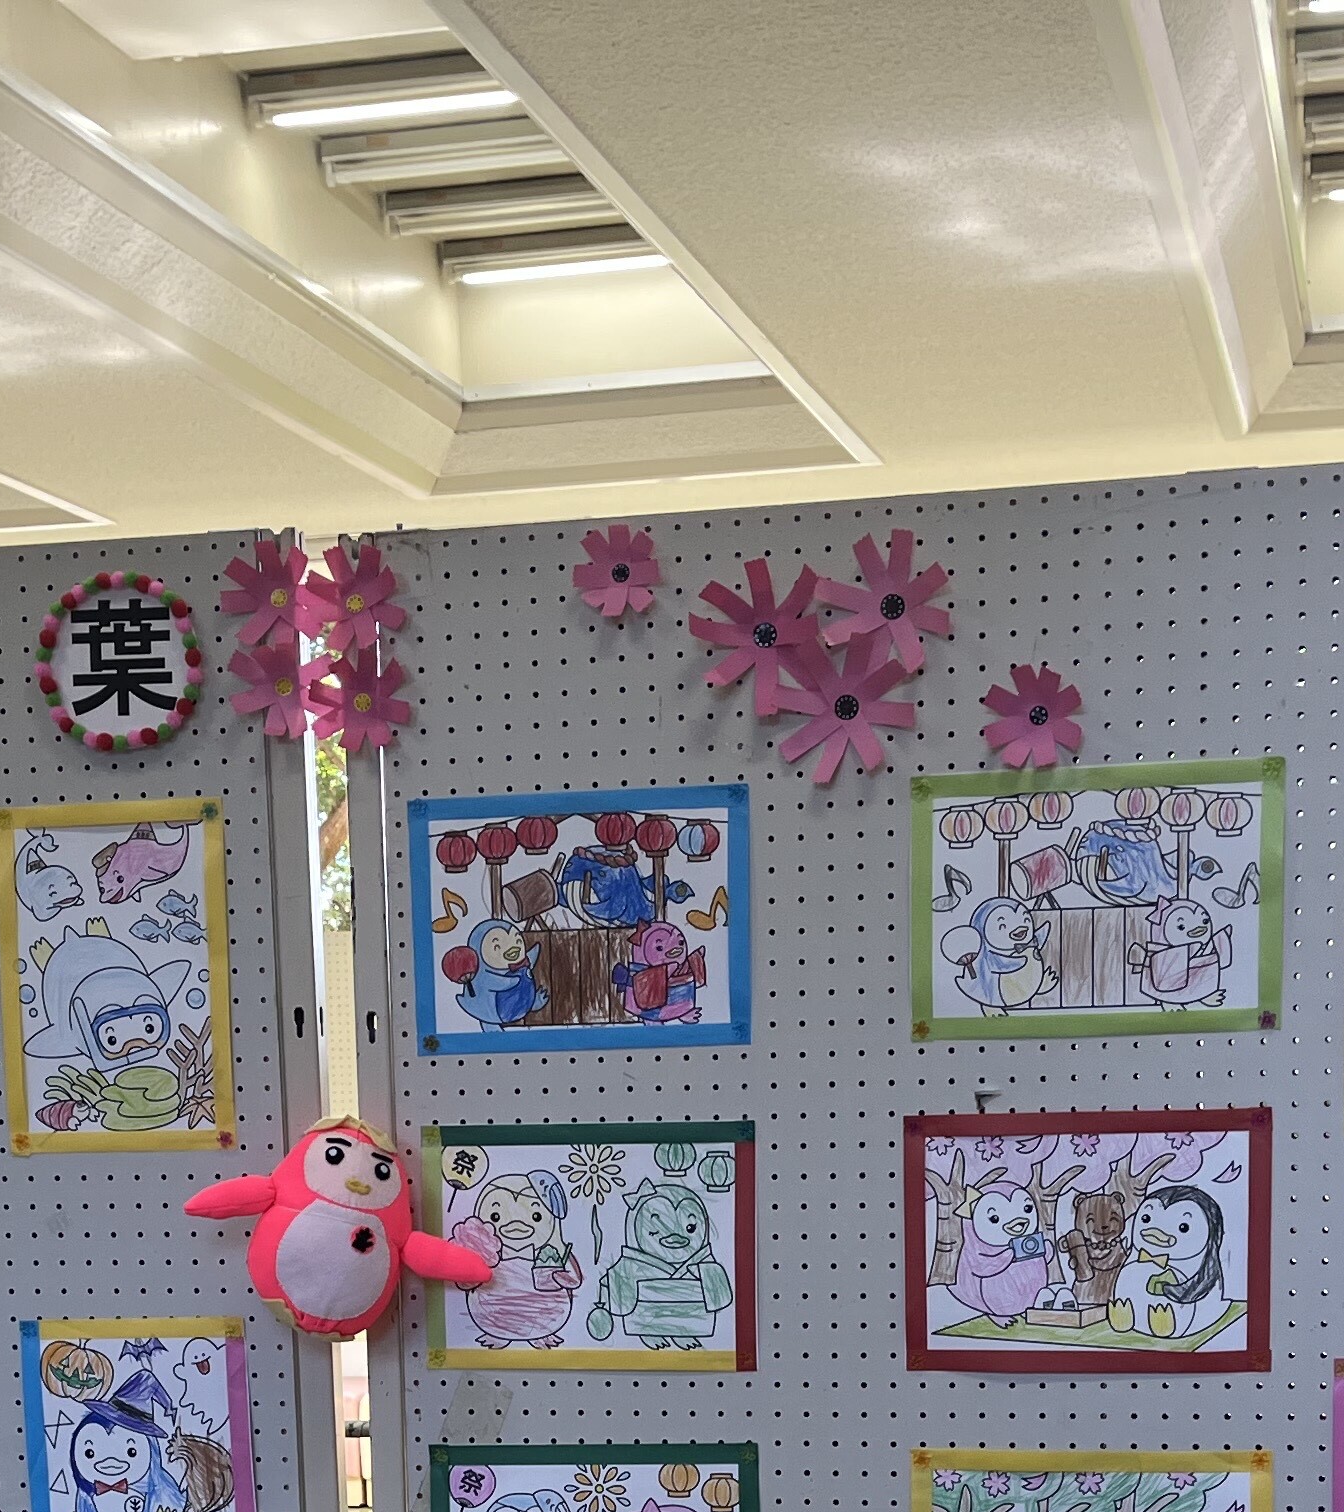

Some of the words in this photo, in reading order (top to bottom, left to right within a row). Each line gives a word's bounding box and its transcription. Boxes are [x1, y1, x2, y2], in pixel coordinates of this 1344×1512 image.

[70, 598, 179, 717] 葉
[452, 1149, 479, 1178] 祭
[458, 1468, 486, 1497] 祭
